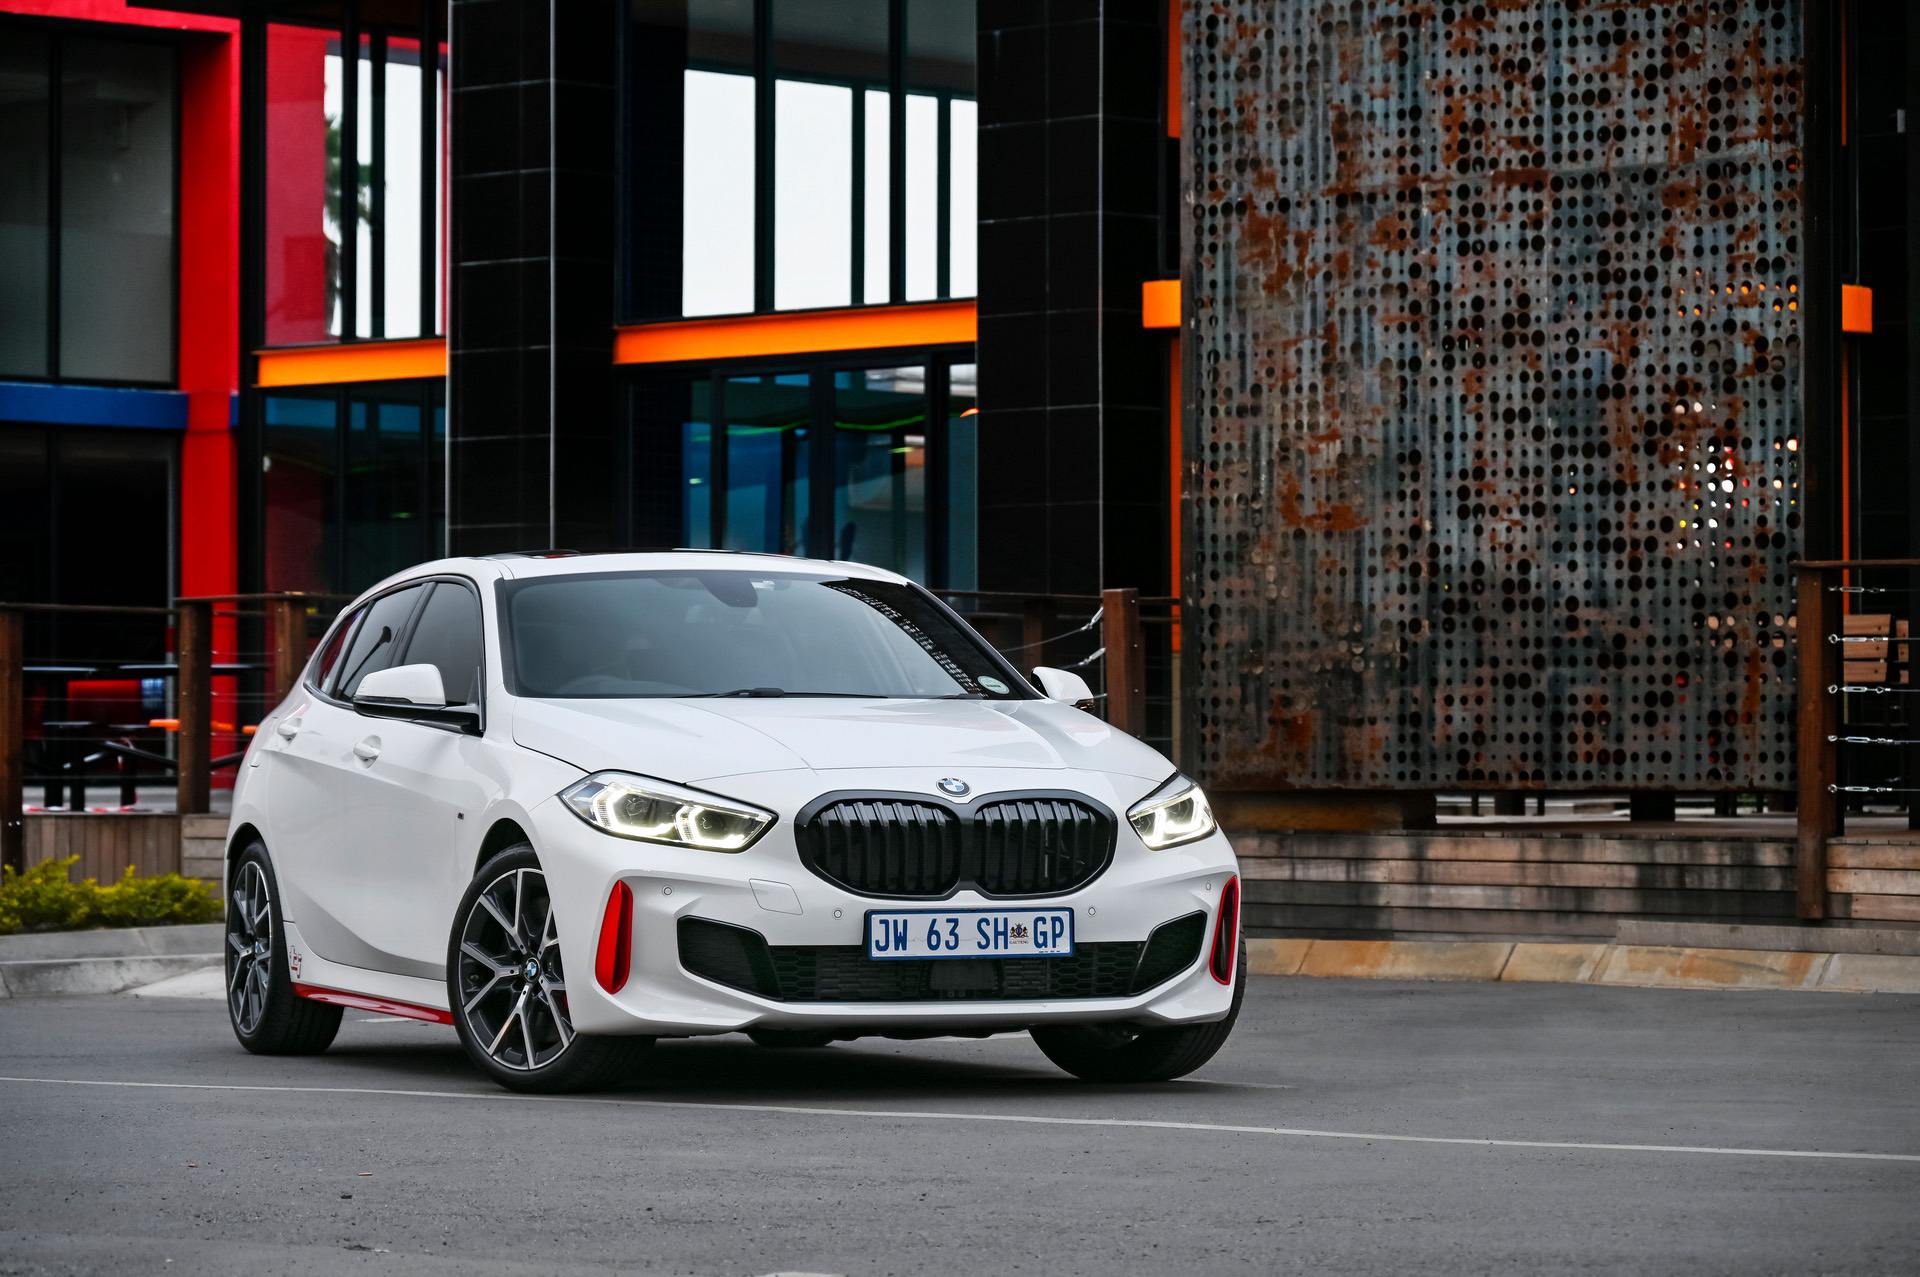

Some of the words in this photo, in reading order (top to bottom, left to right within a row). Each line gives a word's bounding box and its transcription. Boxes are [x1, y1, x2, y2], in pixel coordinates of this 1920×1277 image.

[875, 919, 908, 951] JW
[927, 918, 960, 951] 63
[976, 917, 1009, 950] SH
[1033, 916, 1065, 949] GP
